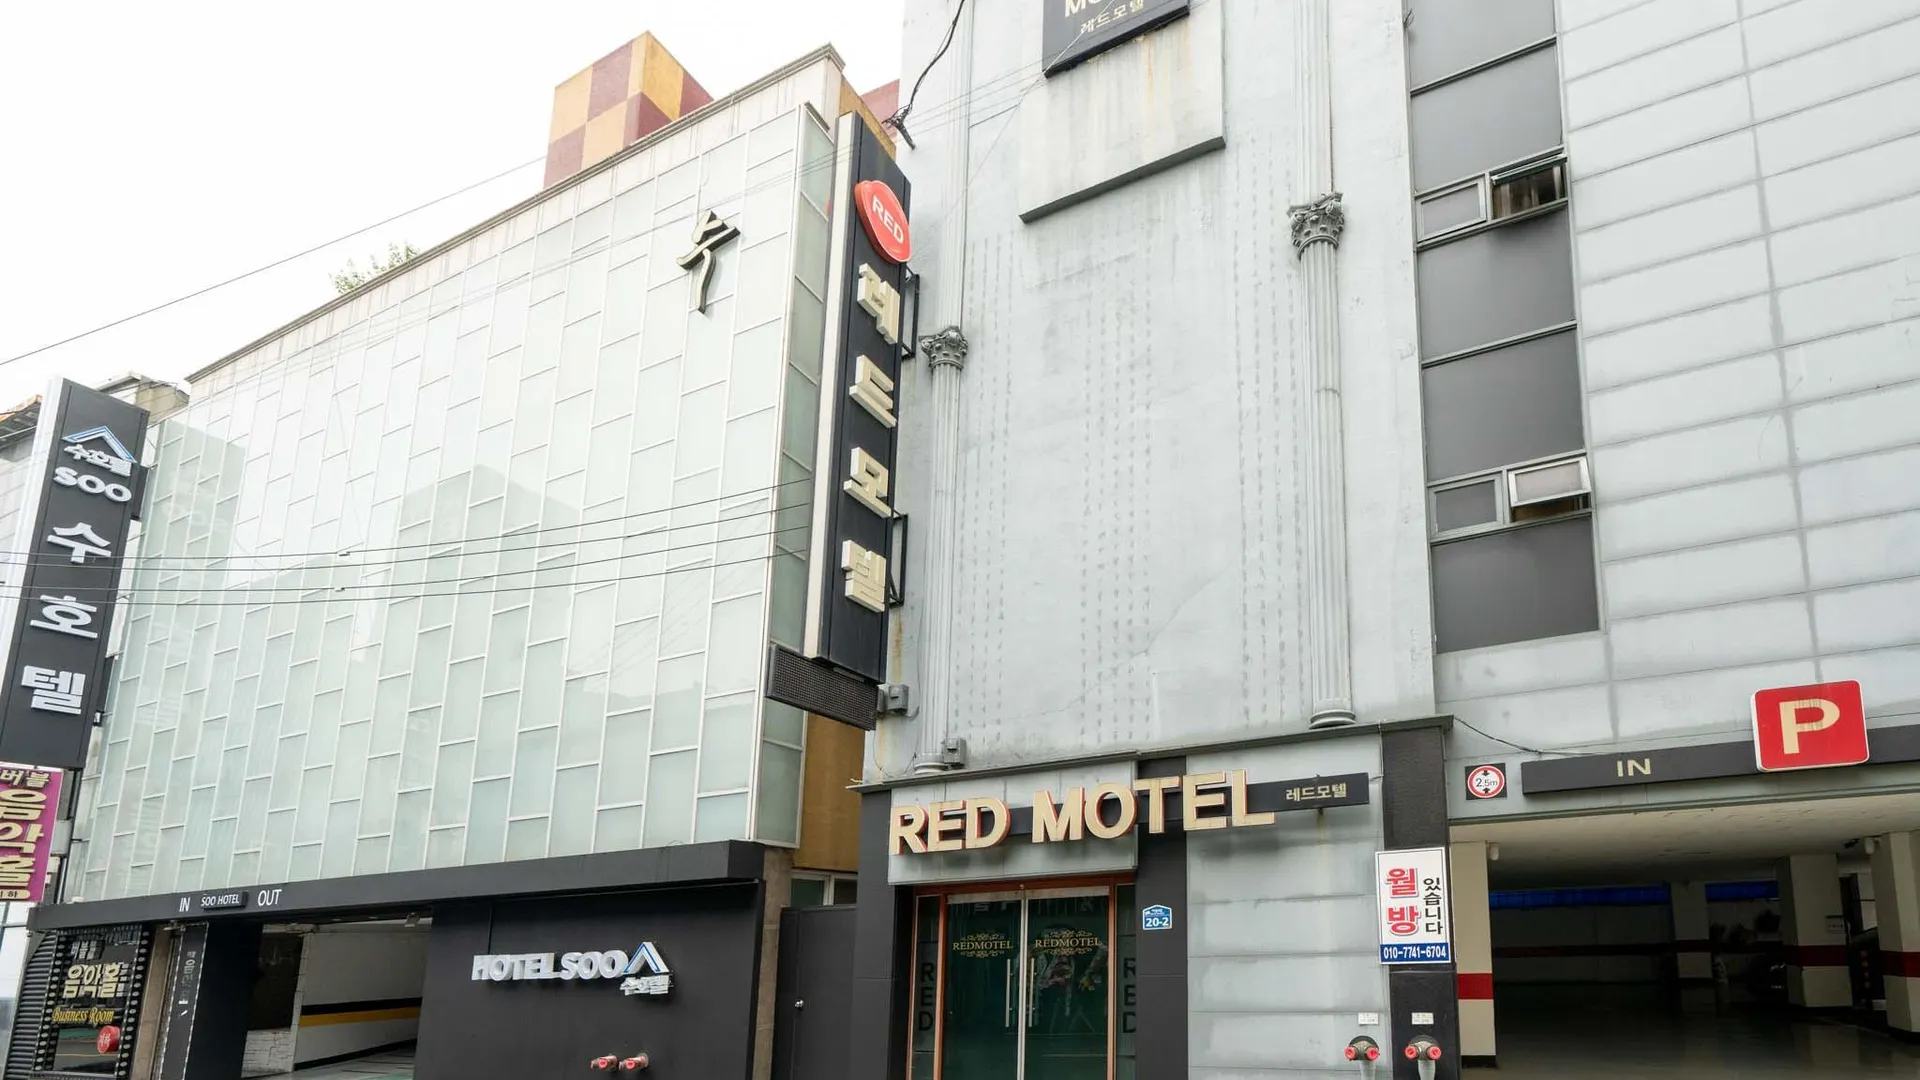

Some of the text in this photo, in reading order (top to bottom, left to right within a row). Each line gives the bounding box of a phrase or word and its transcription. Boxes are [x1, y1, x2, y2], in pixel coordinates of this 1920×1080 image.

[872, 195, 904, 244] RED
[844, 263, 901, 614] 레드모텔
[53, 466, 133, 502] SOO
[21, 521, 112, 716] 수호텔
[1779, 698, 1841, 755] P
[1616, 757, 1652, 778] IN
[1285, 782, 1347, 802] 레드모텔
[890, 768, 1276, 855] RED MOTEL
[179, 897, 191, 912] IN
[200, 894, 240, 907] SOO HOTEL
[257, 889, 282, 906] OUT
[1385, 868, 1420, 935] 월방
[1423, 877, 1444, 935] 있습니다
[1145, 917, 1169, 927] 20-2
[952, 939, 1013, 950] REDMOTEL
[1034, 937, 1102, 949] REDMOTEL
[1383, 945, 1447, 959] 010-7741-6704
[62, 963, 121, 998] 음악홀
[471, 949, 629, 981] HOTEL SOO
[918, 962, 935, 1031] RED
[89, 1006, 115, 1026] Room
